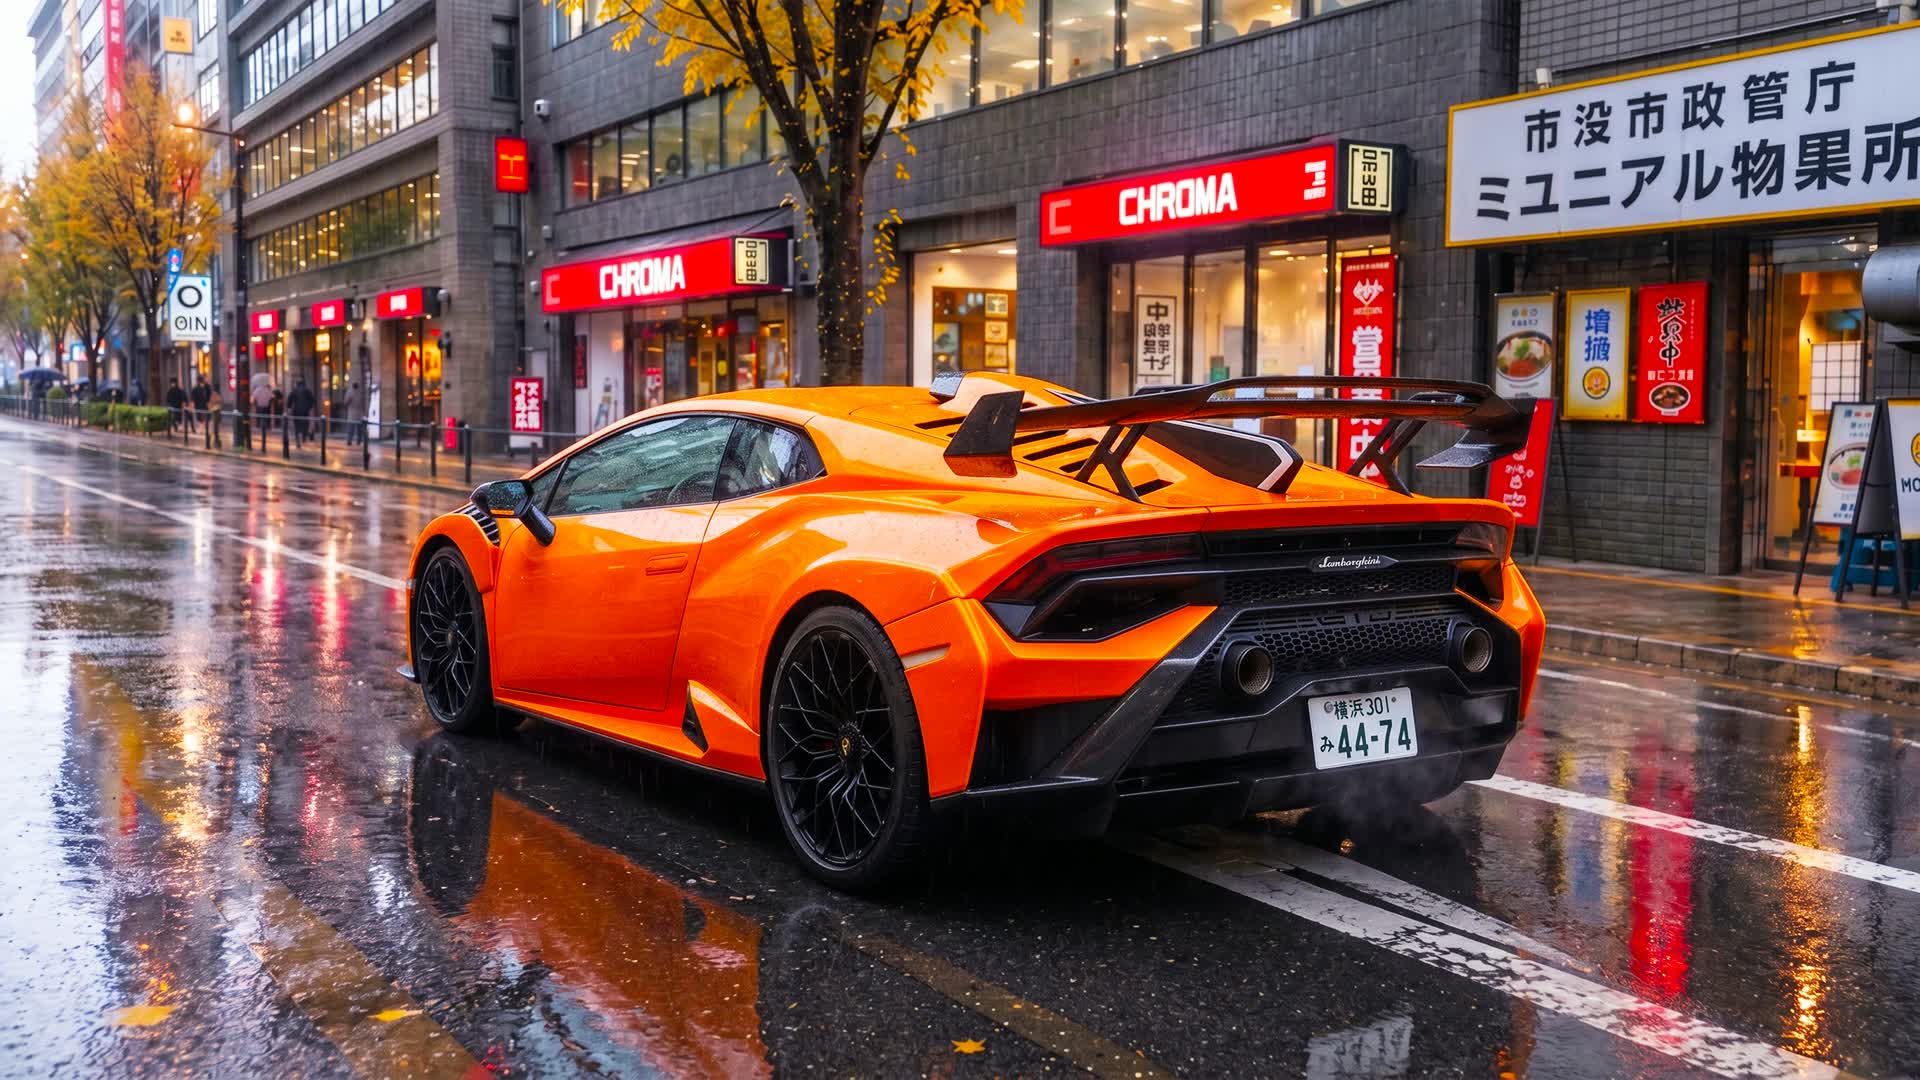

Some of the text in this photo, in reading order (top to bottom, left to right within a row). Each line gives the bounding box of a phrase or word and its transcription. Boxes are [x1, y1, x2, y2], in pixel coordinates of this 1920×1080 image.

[1119, 172, 1238, 226] CHROMA
[599, 254, 686, 300] CHROMA
[1320, 717, 1411, 759] み 44-74
